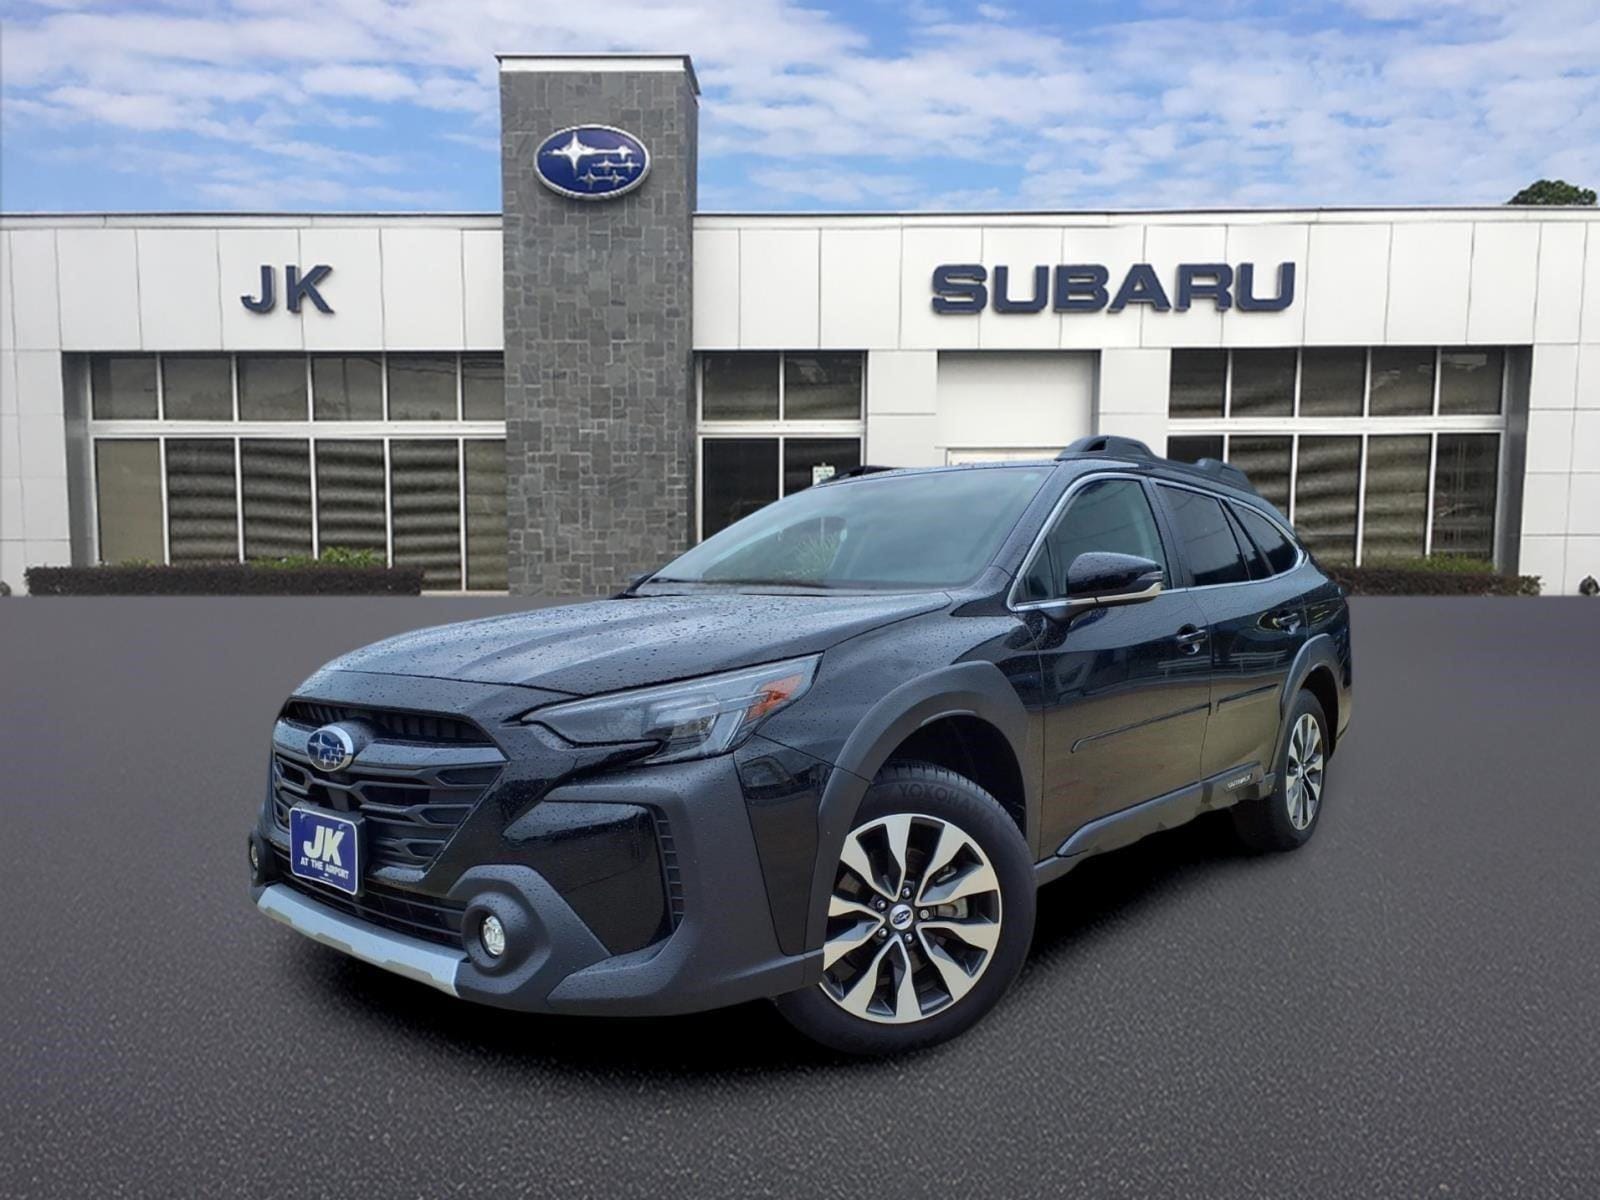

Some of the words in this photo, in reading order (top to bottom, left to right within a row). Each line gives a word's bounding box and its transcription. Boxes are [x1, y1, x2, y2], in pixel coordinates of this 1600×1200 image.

[240, 264, 335, 315] JK
[931, 262, 1296, 315] SUBARU
[300, 857, 309, 866] AT
[311, 860, 324, 870] THE
[303, 825, 344, 866] JK
